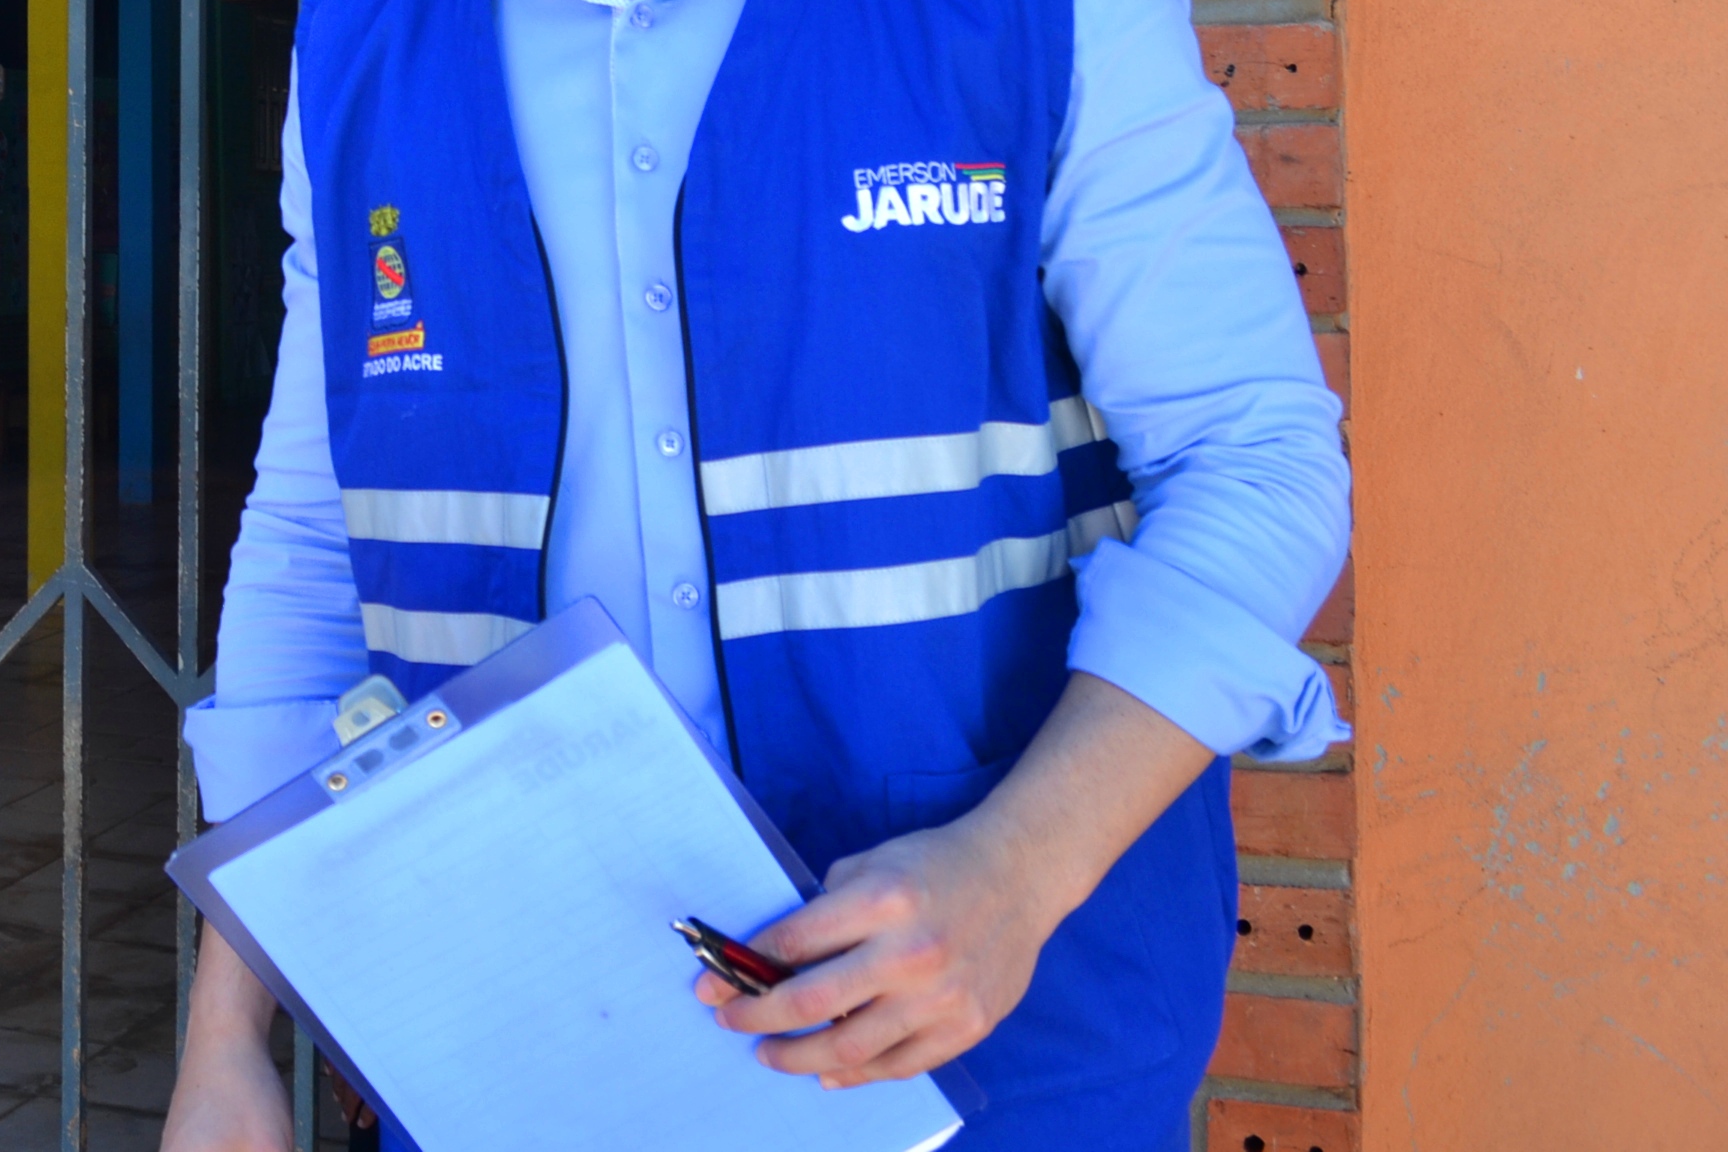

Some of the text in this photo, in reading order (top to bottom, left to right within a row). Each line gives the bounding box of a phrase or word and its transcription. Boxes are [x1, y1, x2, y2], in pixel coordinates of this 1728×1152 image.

[853, 160, 957, 190] EMERSON
[840, 181, 1006, 233] JARUDE
[402, 352, 444, 372] ACRE
